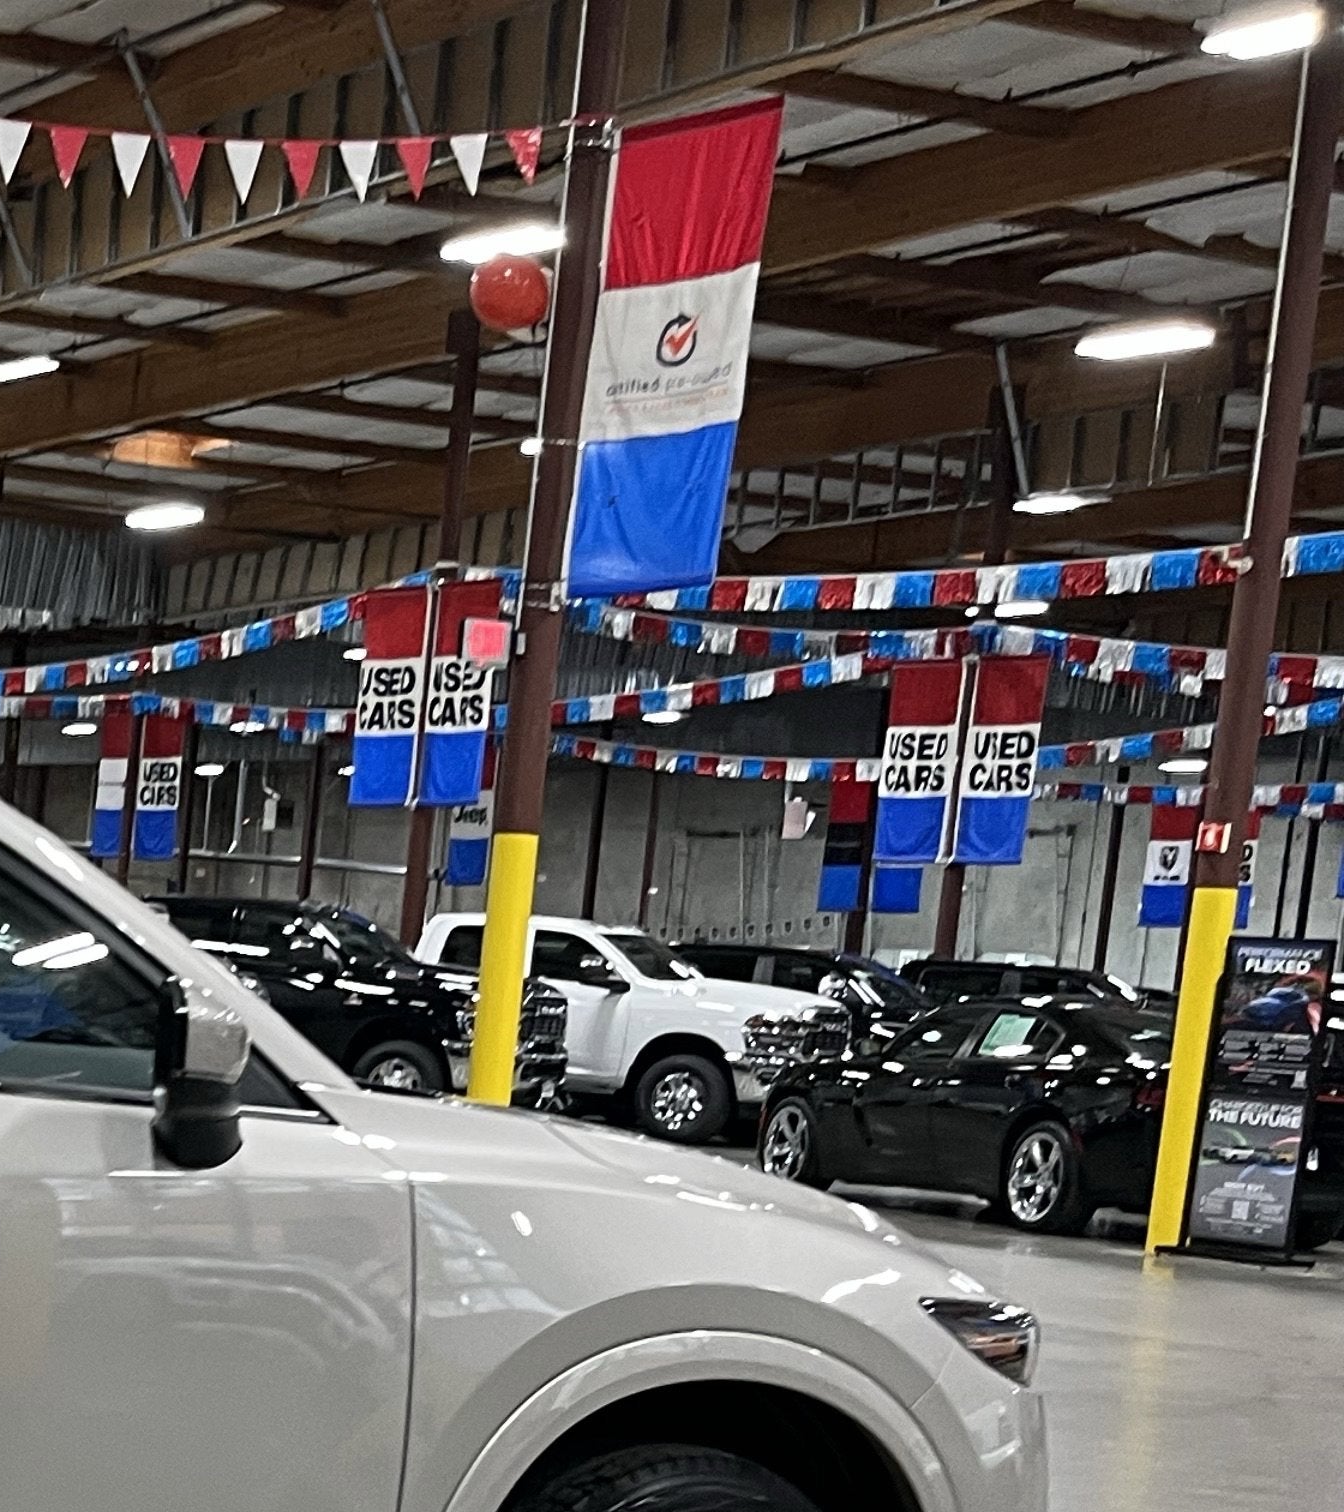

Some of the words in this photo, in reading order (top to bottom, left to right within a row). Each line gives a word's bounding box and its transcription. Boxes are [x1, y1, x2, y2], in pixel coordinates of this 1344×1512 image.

[361, 666, 416, 697] USED
[359, 699, 416, 730] CARS
[428, 694, 483, 727] CARS
[889, 732, 948, 760] USED
[974, 731, 1035, 760] USED
[885, 764, 945, 792] CARS
